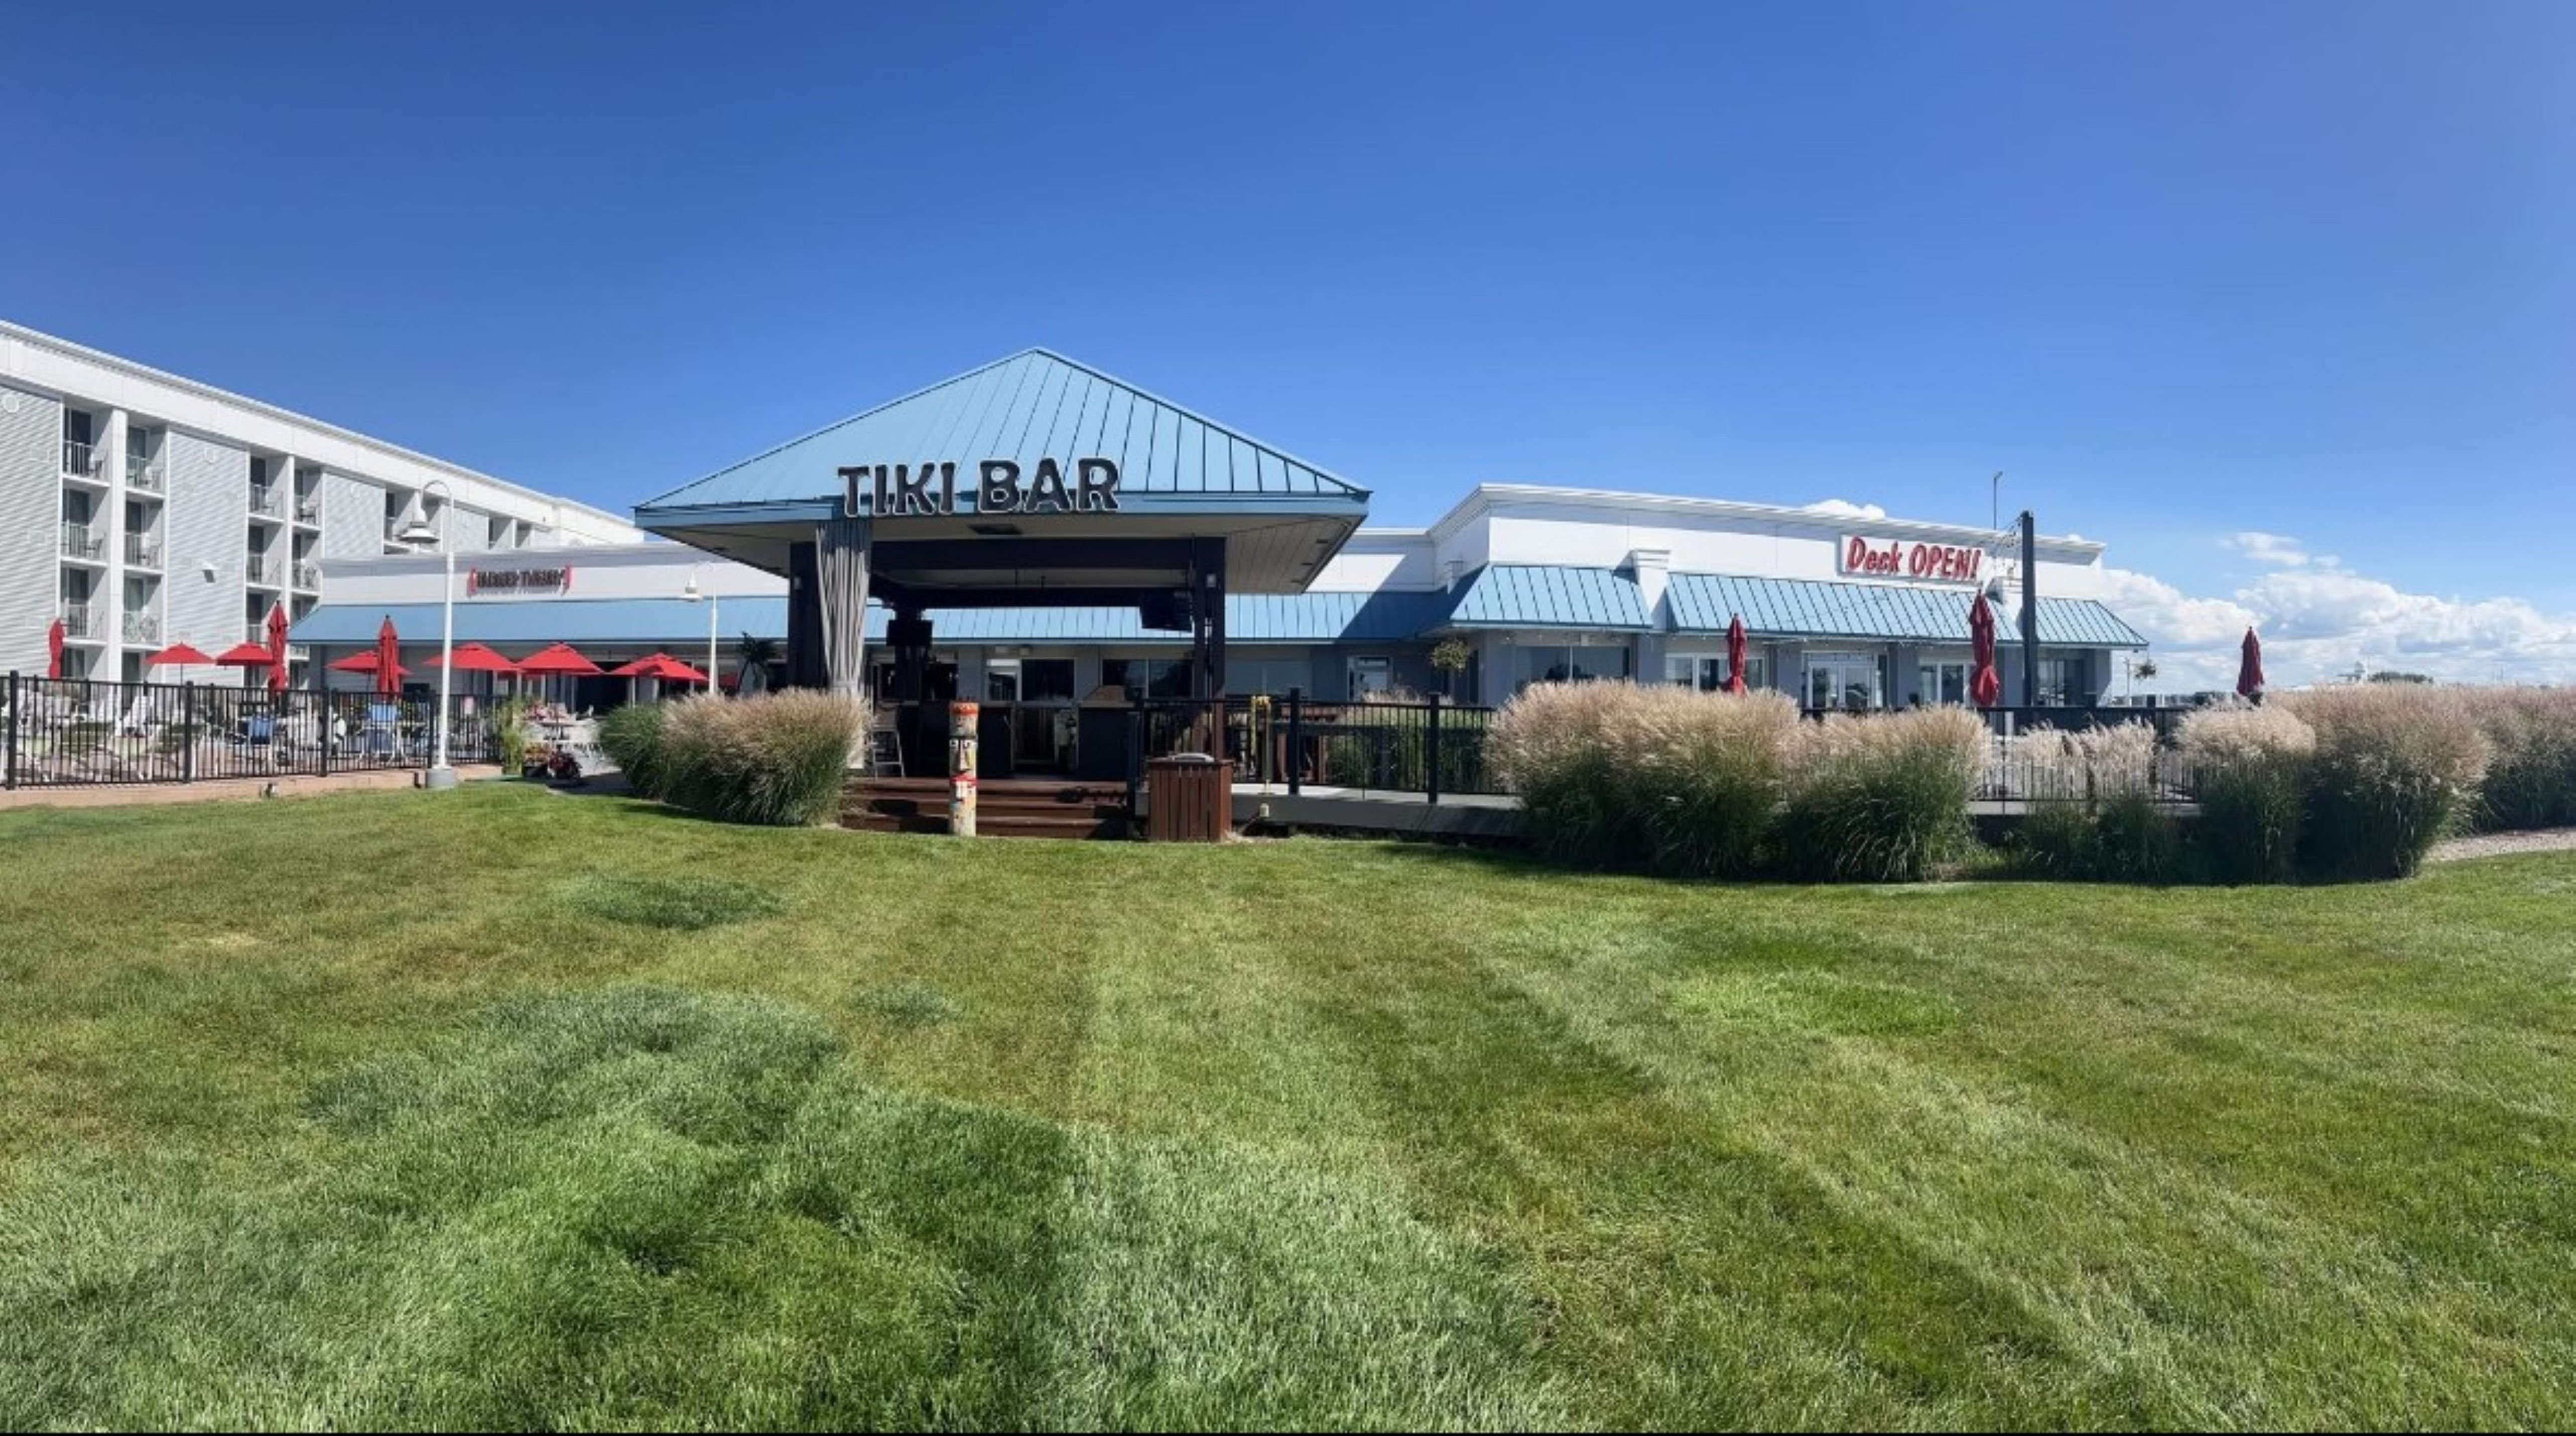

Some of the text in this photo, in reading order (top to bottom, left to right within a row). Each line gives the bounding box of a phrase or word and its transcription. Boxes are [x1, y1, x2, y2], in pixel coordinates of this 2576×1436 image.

[838, 458, 1119, 517] TIKI BAR
[1846, 536, 1981, 579] Deck OPEN!
